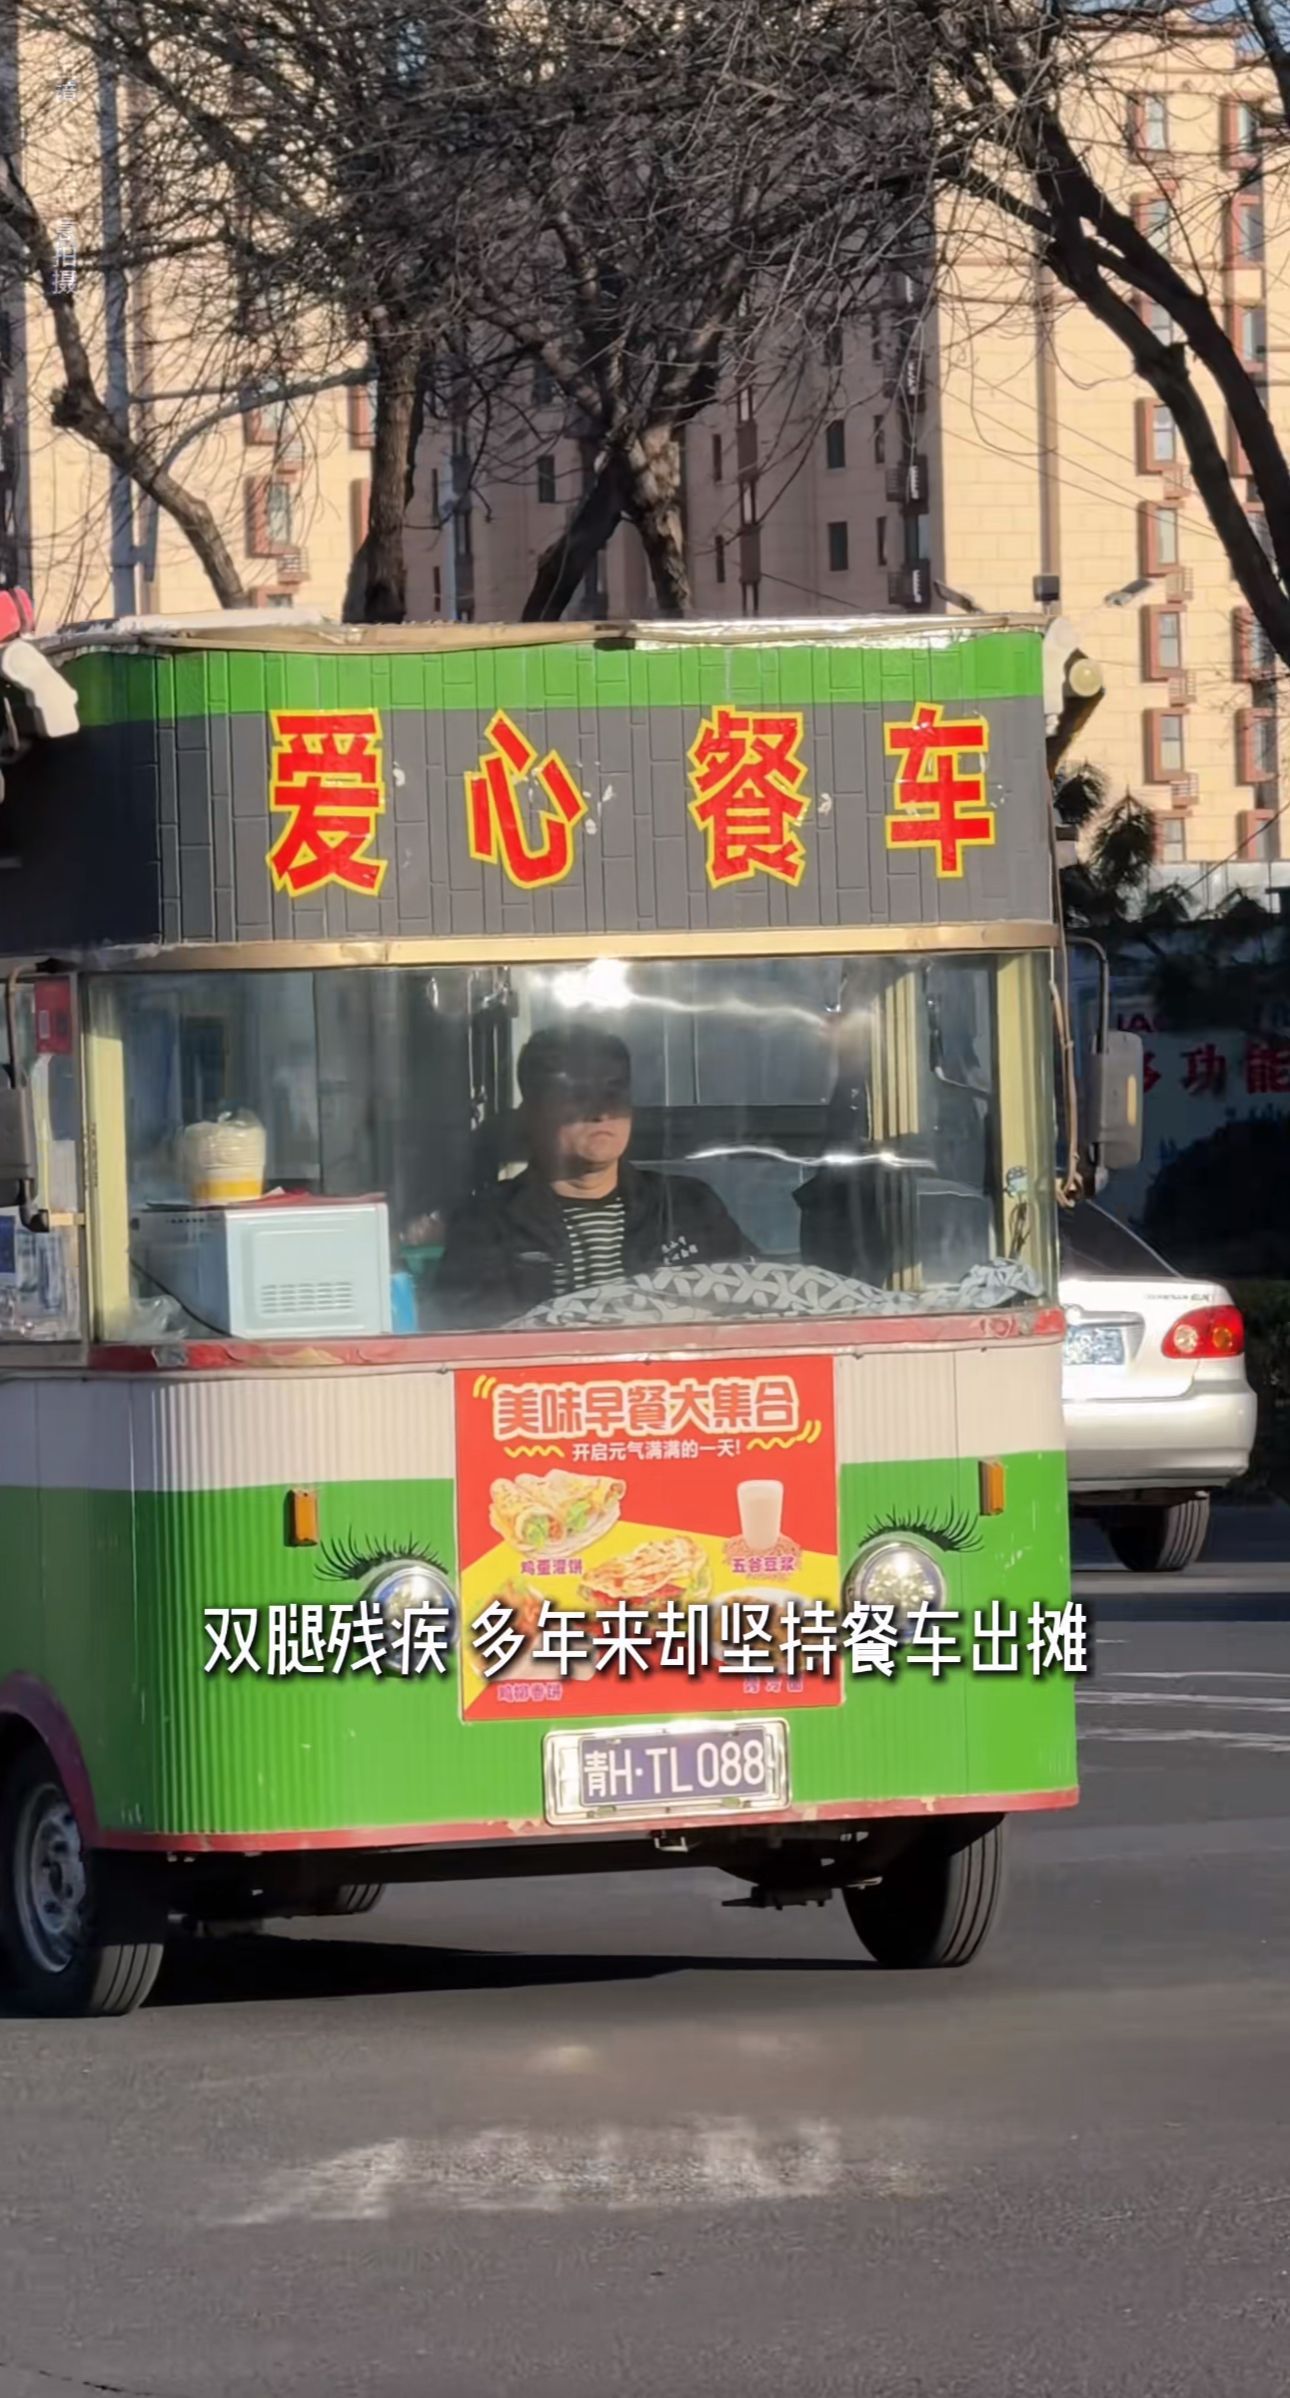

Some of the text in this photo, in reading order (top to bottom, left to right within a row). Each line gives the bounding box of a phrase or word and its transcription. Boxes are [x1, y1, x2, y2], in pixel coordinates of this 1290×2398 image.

[266, 703, 996, 897] 爱心餐车
[494, 1377, 799, 1440] 美味早餐大集合
[731, 1555, 795, 1574] 五谷豆浆
[583, 1740, 765, 1797] 青H·TL088
